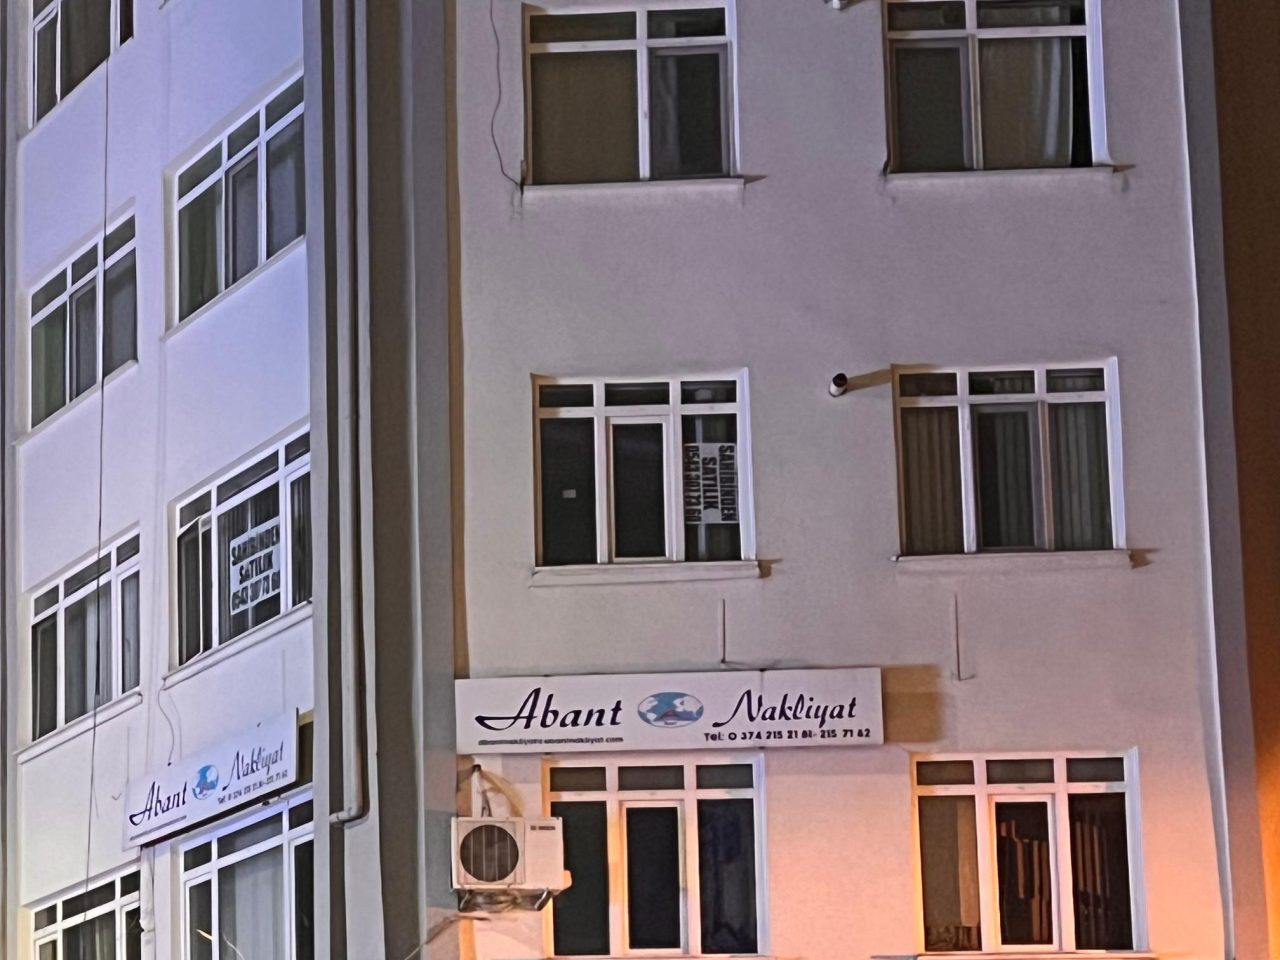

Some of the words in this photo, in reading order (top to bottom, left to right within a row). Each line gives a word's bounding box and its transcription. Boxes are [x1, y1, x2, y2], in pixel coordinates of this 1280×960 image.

[702, 457, 719, 511] SATILIK
[475, 687, 622, 731] Abant
[712, 689, 857, 730] Nakliyat
[741, 731, 762, 741] 374
[129, 781, 188, 826] Abant
[222, 740, 284, 791] Nakliyat
